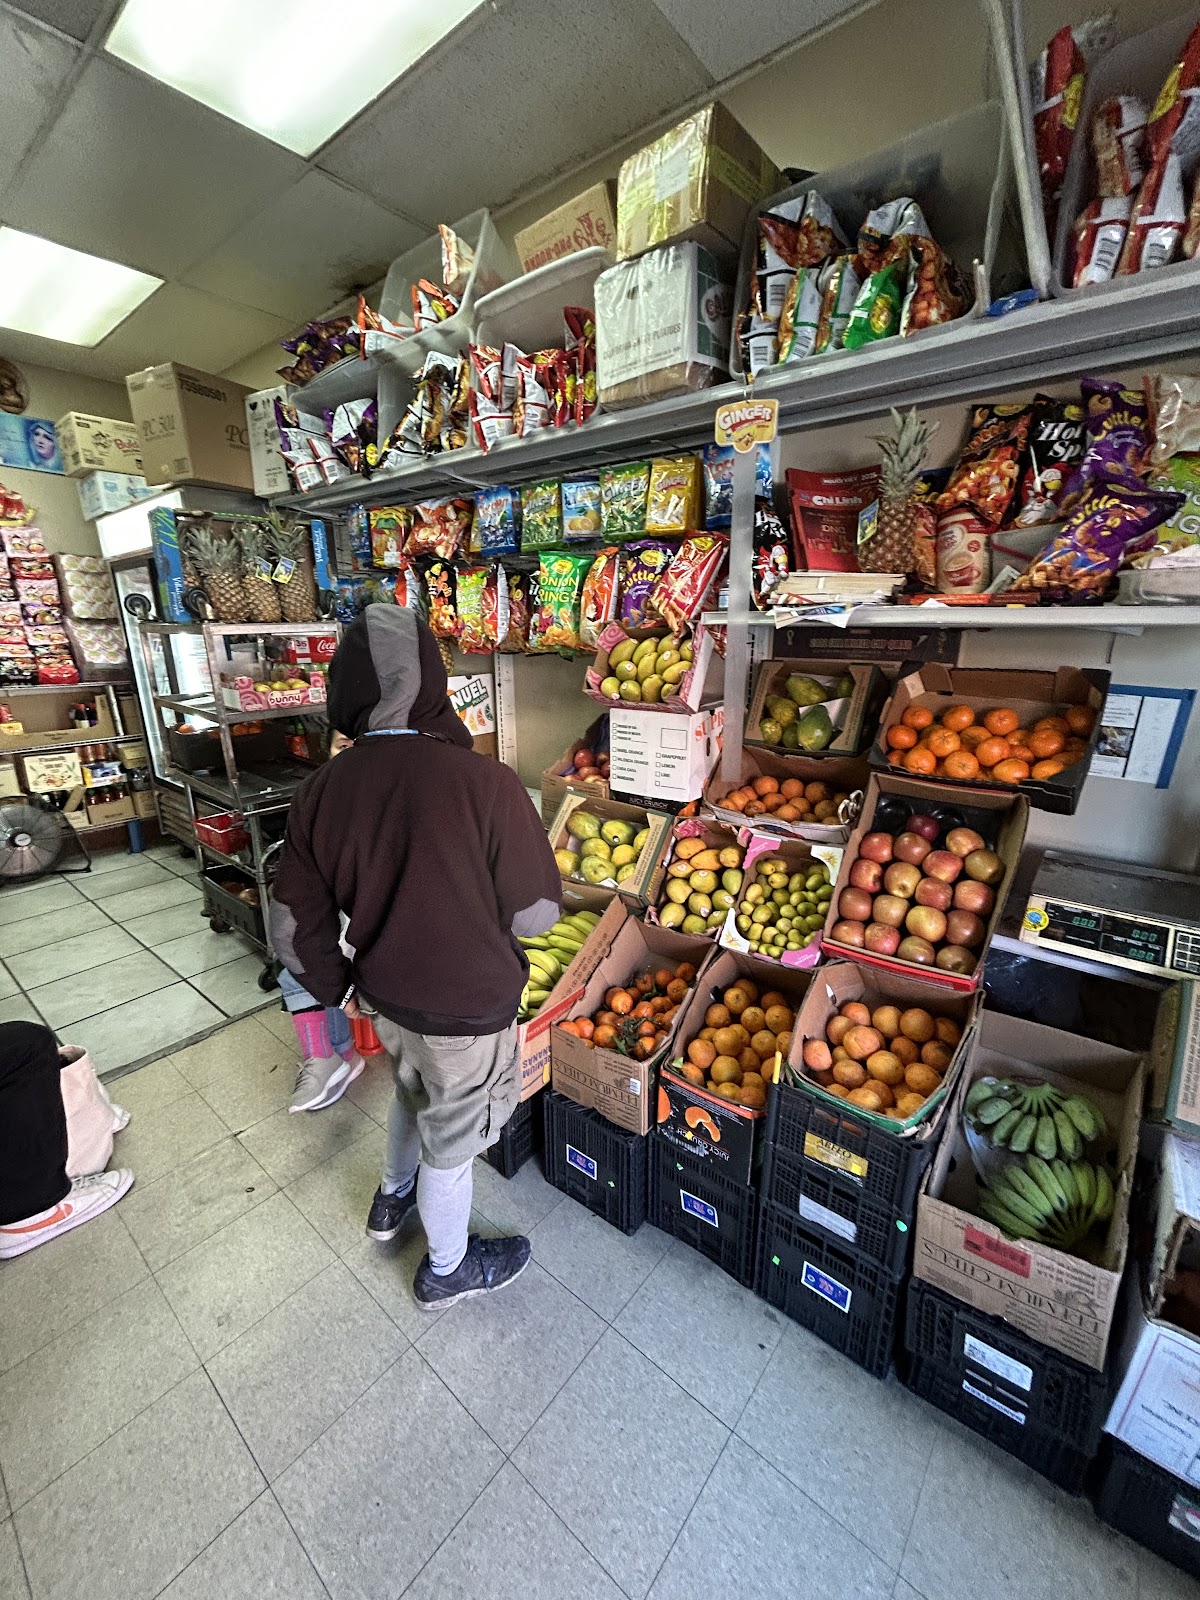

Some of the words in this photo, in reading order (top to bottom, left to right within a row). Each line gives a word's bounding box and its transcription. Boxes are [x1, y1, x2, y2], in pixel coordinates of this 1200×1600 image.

[718, 404, 772, 430] GINGER
[655, 475, 689, 491] GINGER
[541, 576, 577, 587] ONION
[539, 590, 580, 604] RINGS
[317, 639, 336, 654] Coca
[269, 693, 300, 705] bunny
[450, 679, 487, 710] NUEL
[644, 799, 668, 809] CRUNCH
[554, 1060, 588, 1084] CITRUS
[589, 1076, 638, 1107] PREMIUM
[709, 1146, 730, 1162] JUICY
[923, 1241, 991, 1283] CITRUS
[998, 1276, 1100, 1334] PREMIUM
